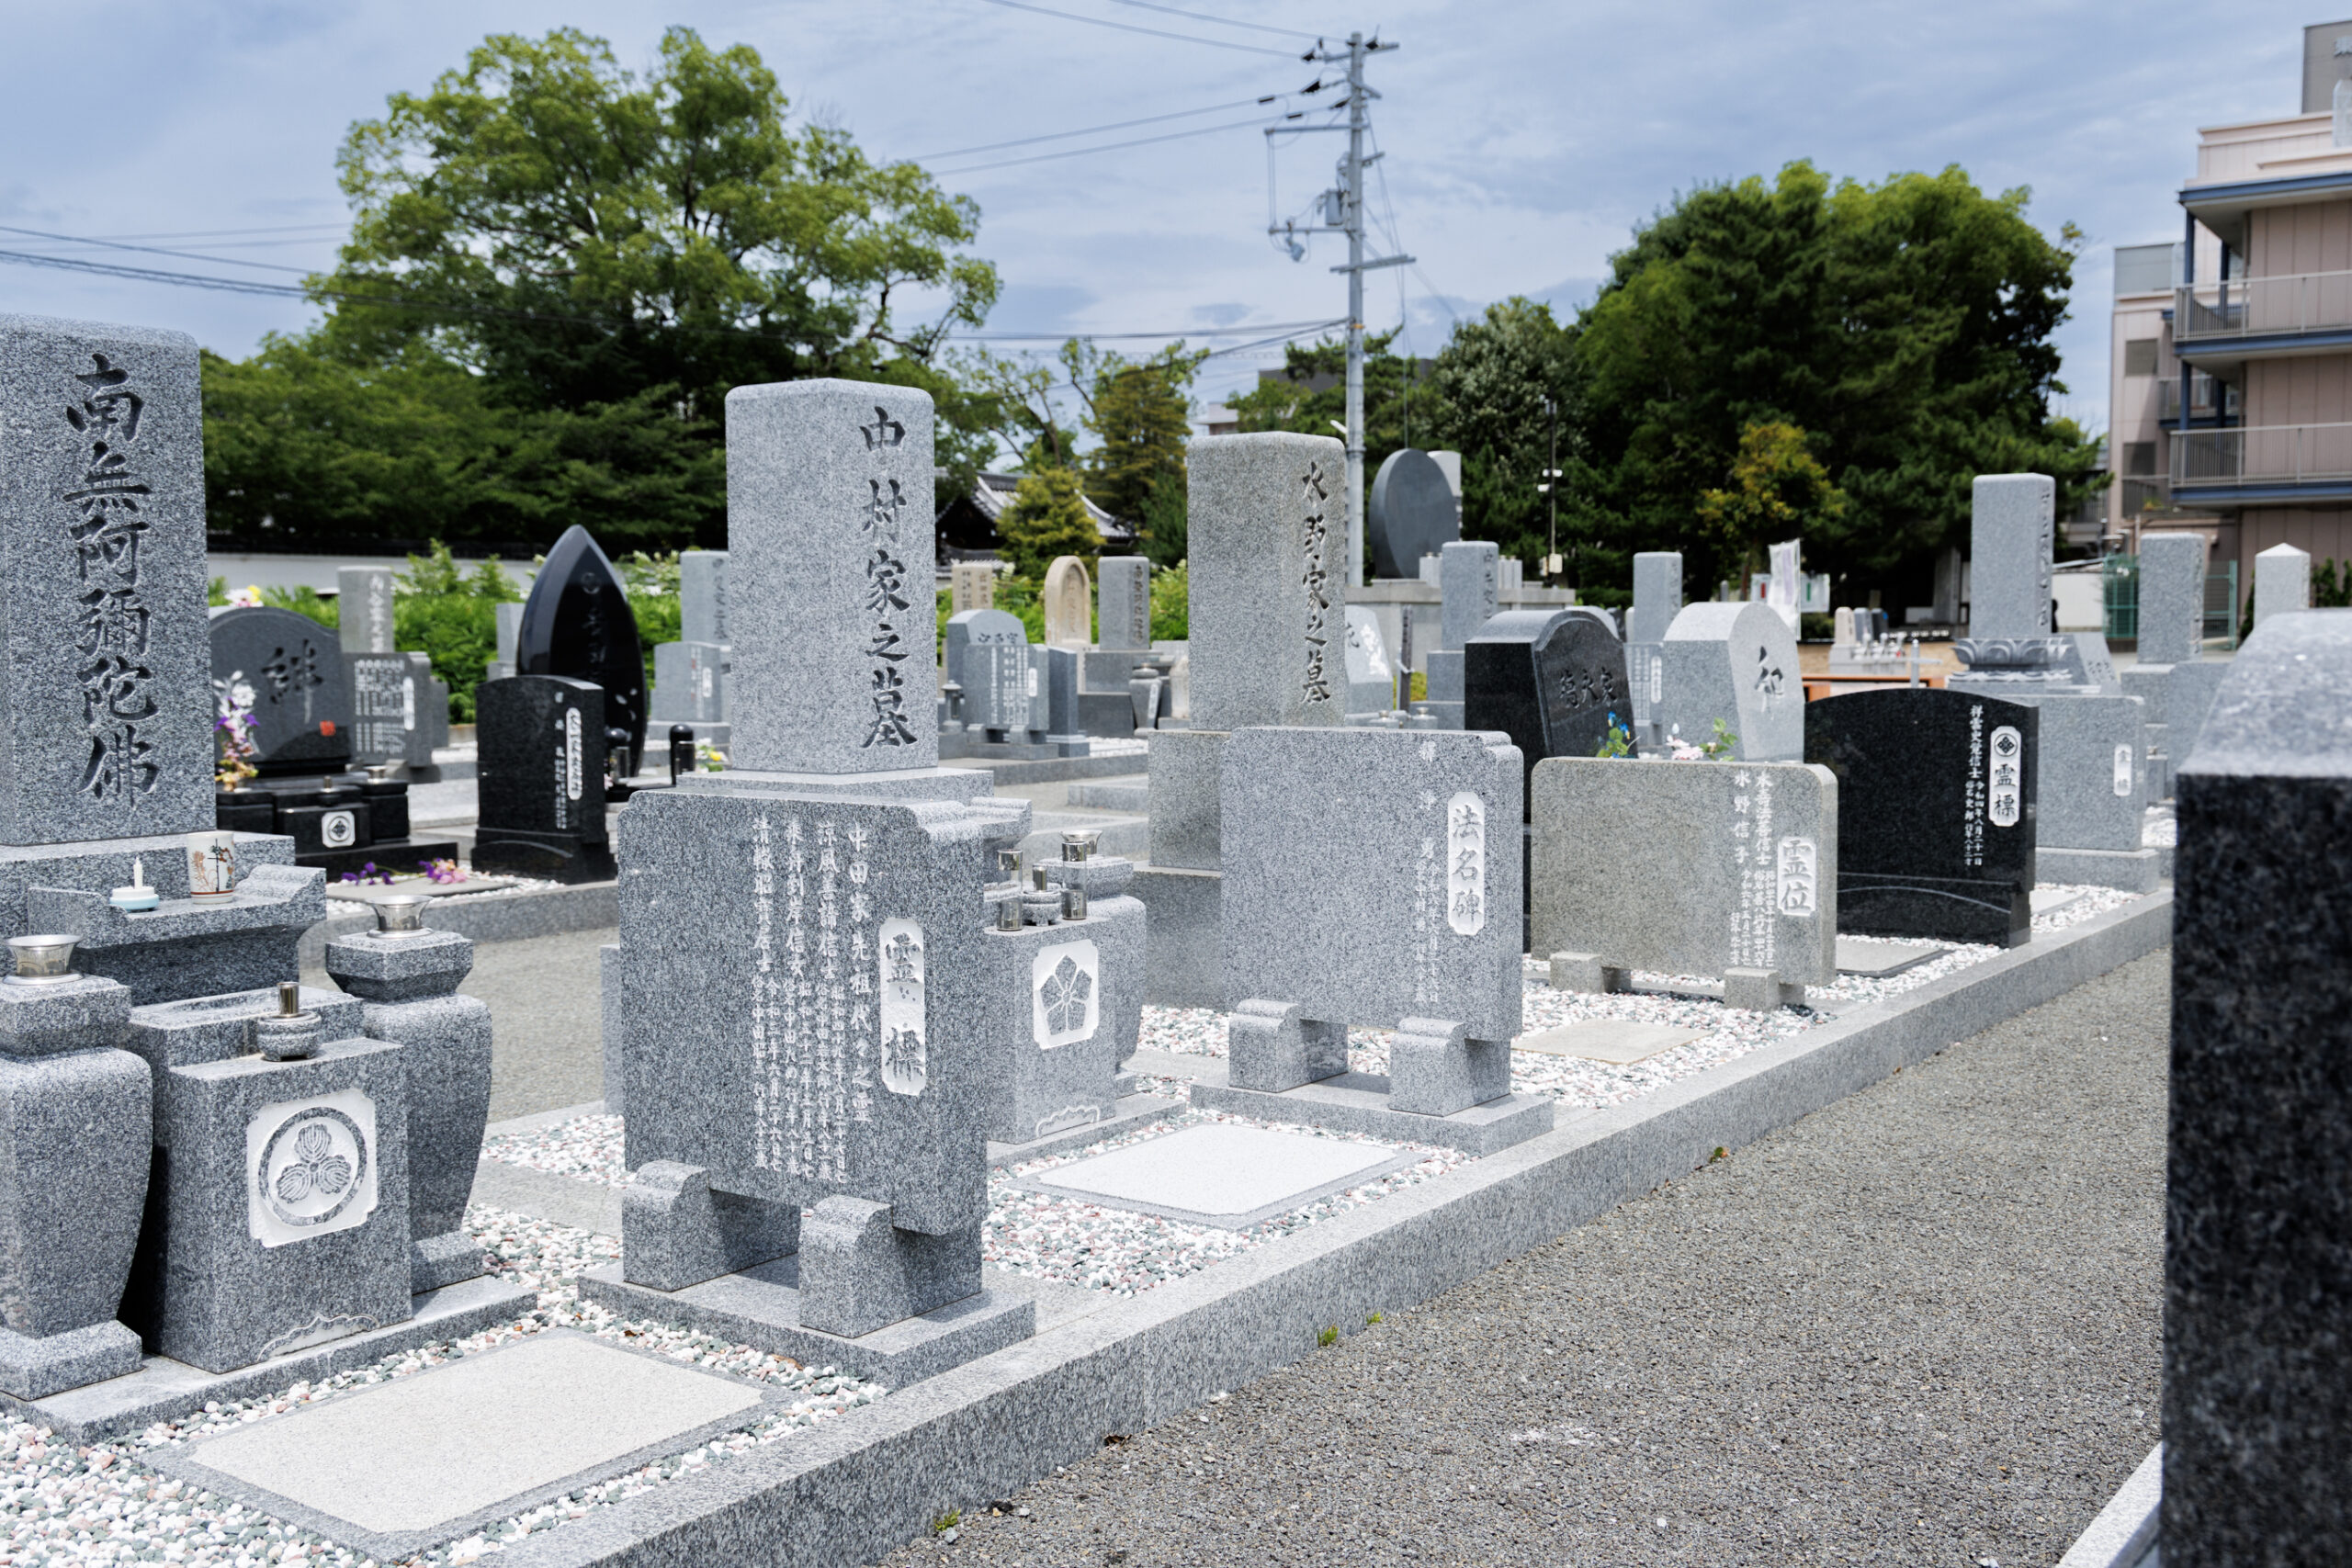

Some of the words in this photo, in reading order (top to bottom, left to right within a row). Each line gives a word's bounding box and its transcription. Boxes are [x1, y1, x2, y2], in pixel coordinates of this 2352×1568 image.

[860, 406, 917, 748] 中村家之墓
[1302, 461, 1330, 704] 水野家之墓
[261, 638, 323, 724] 絆
[1754, 645, 1784, 720] 和
[1734, 770, 1751, 863] 水野信子
[1995, 763, 2016, 817] 霊標
[1452, 805, 1481, 924] 法名碑
[1781, 840, 1813, 911] 霊位
